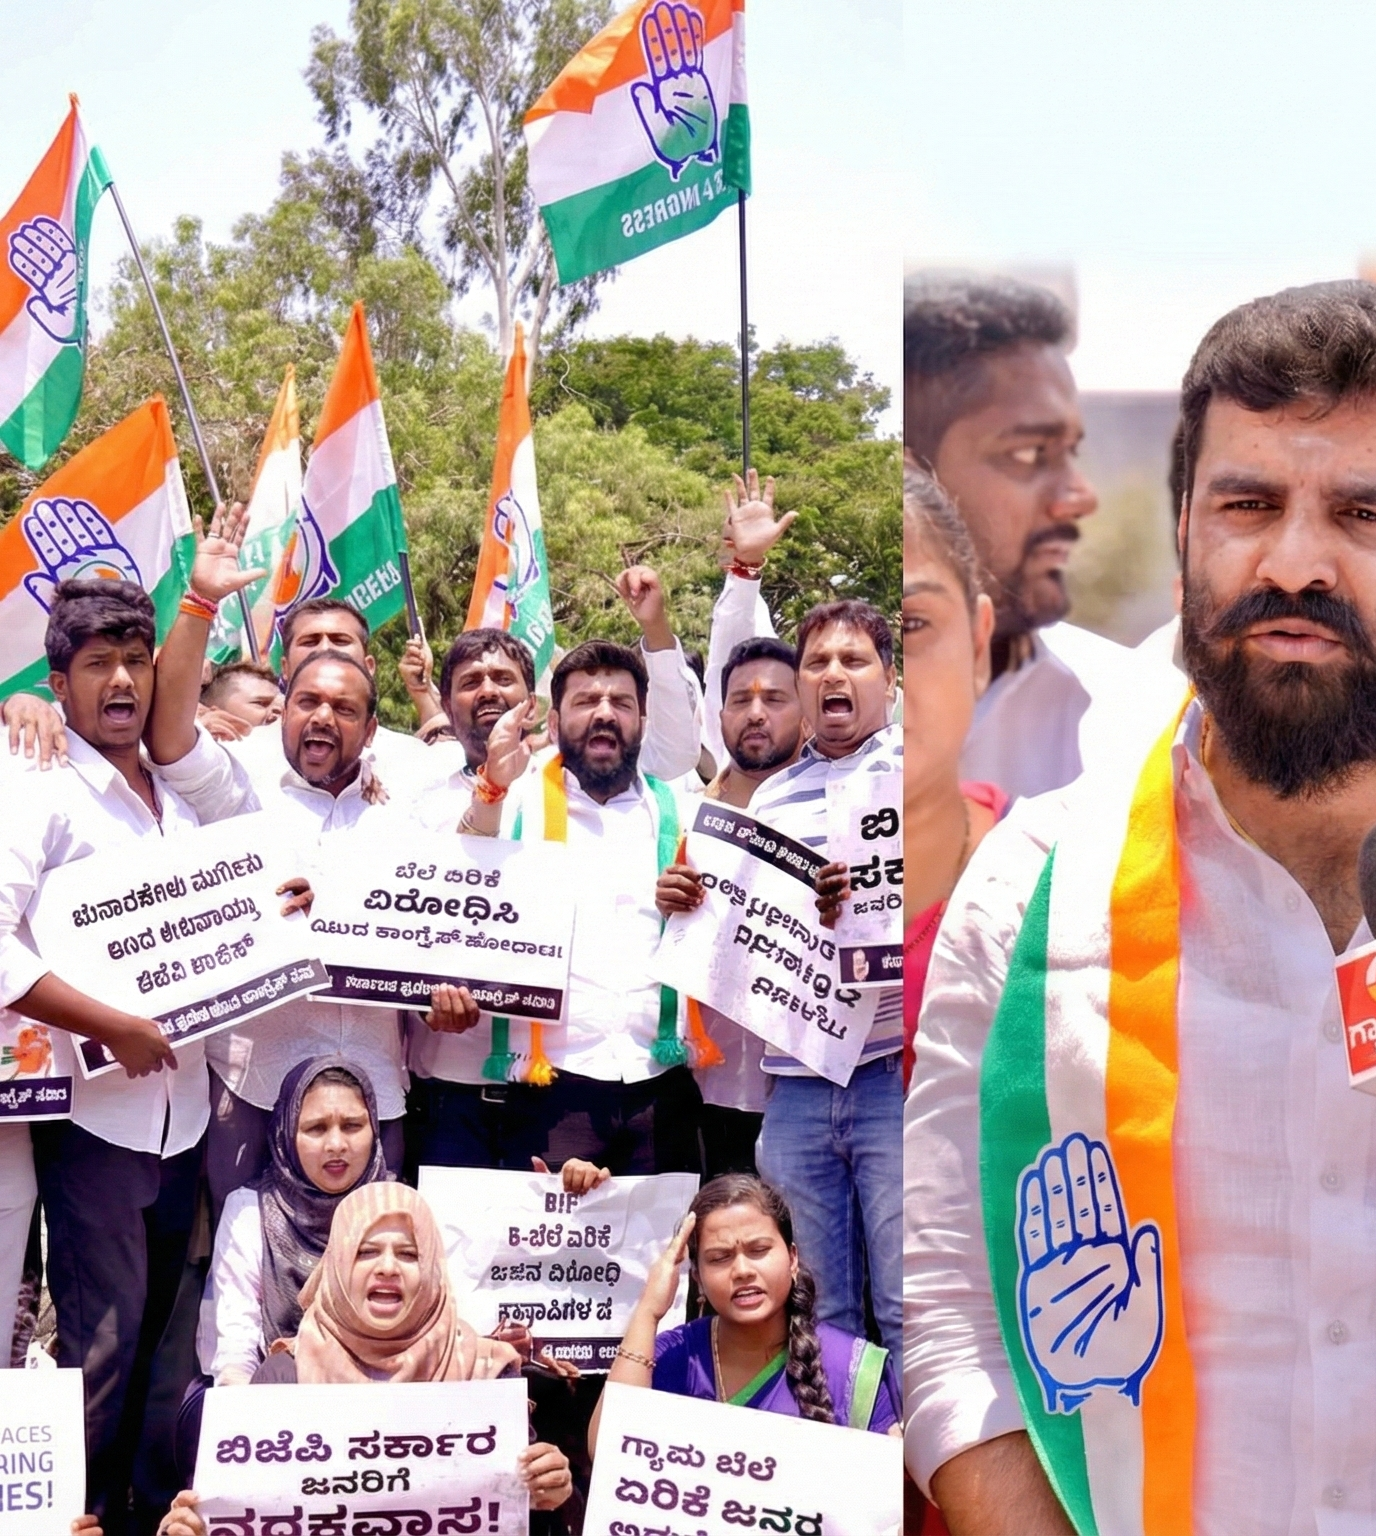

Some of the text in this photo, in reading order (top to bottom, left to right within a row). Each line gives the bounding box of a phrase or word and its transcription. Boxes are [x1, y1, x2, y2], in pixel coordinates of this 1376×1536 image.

[1, 1425, 52, 1444] ACES
[216, 1425, 497, 1465] ಬಿಜೆಪಿ ಸರ್ಕಾರ
[301, 1467, 411, 1496] ಜನರಿಗೆ
[715, 1451, 777, 1482] ಬೆಲೆ
